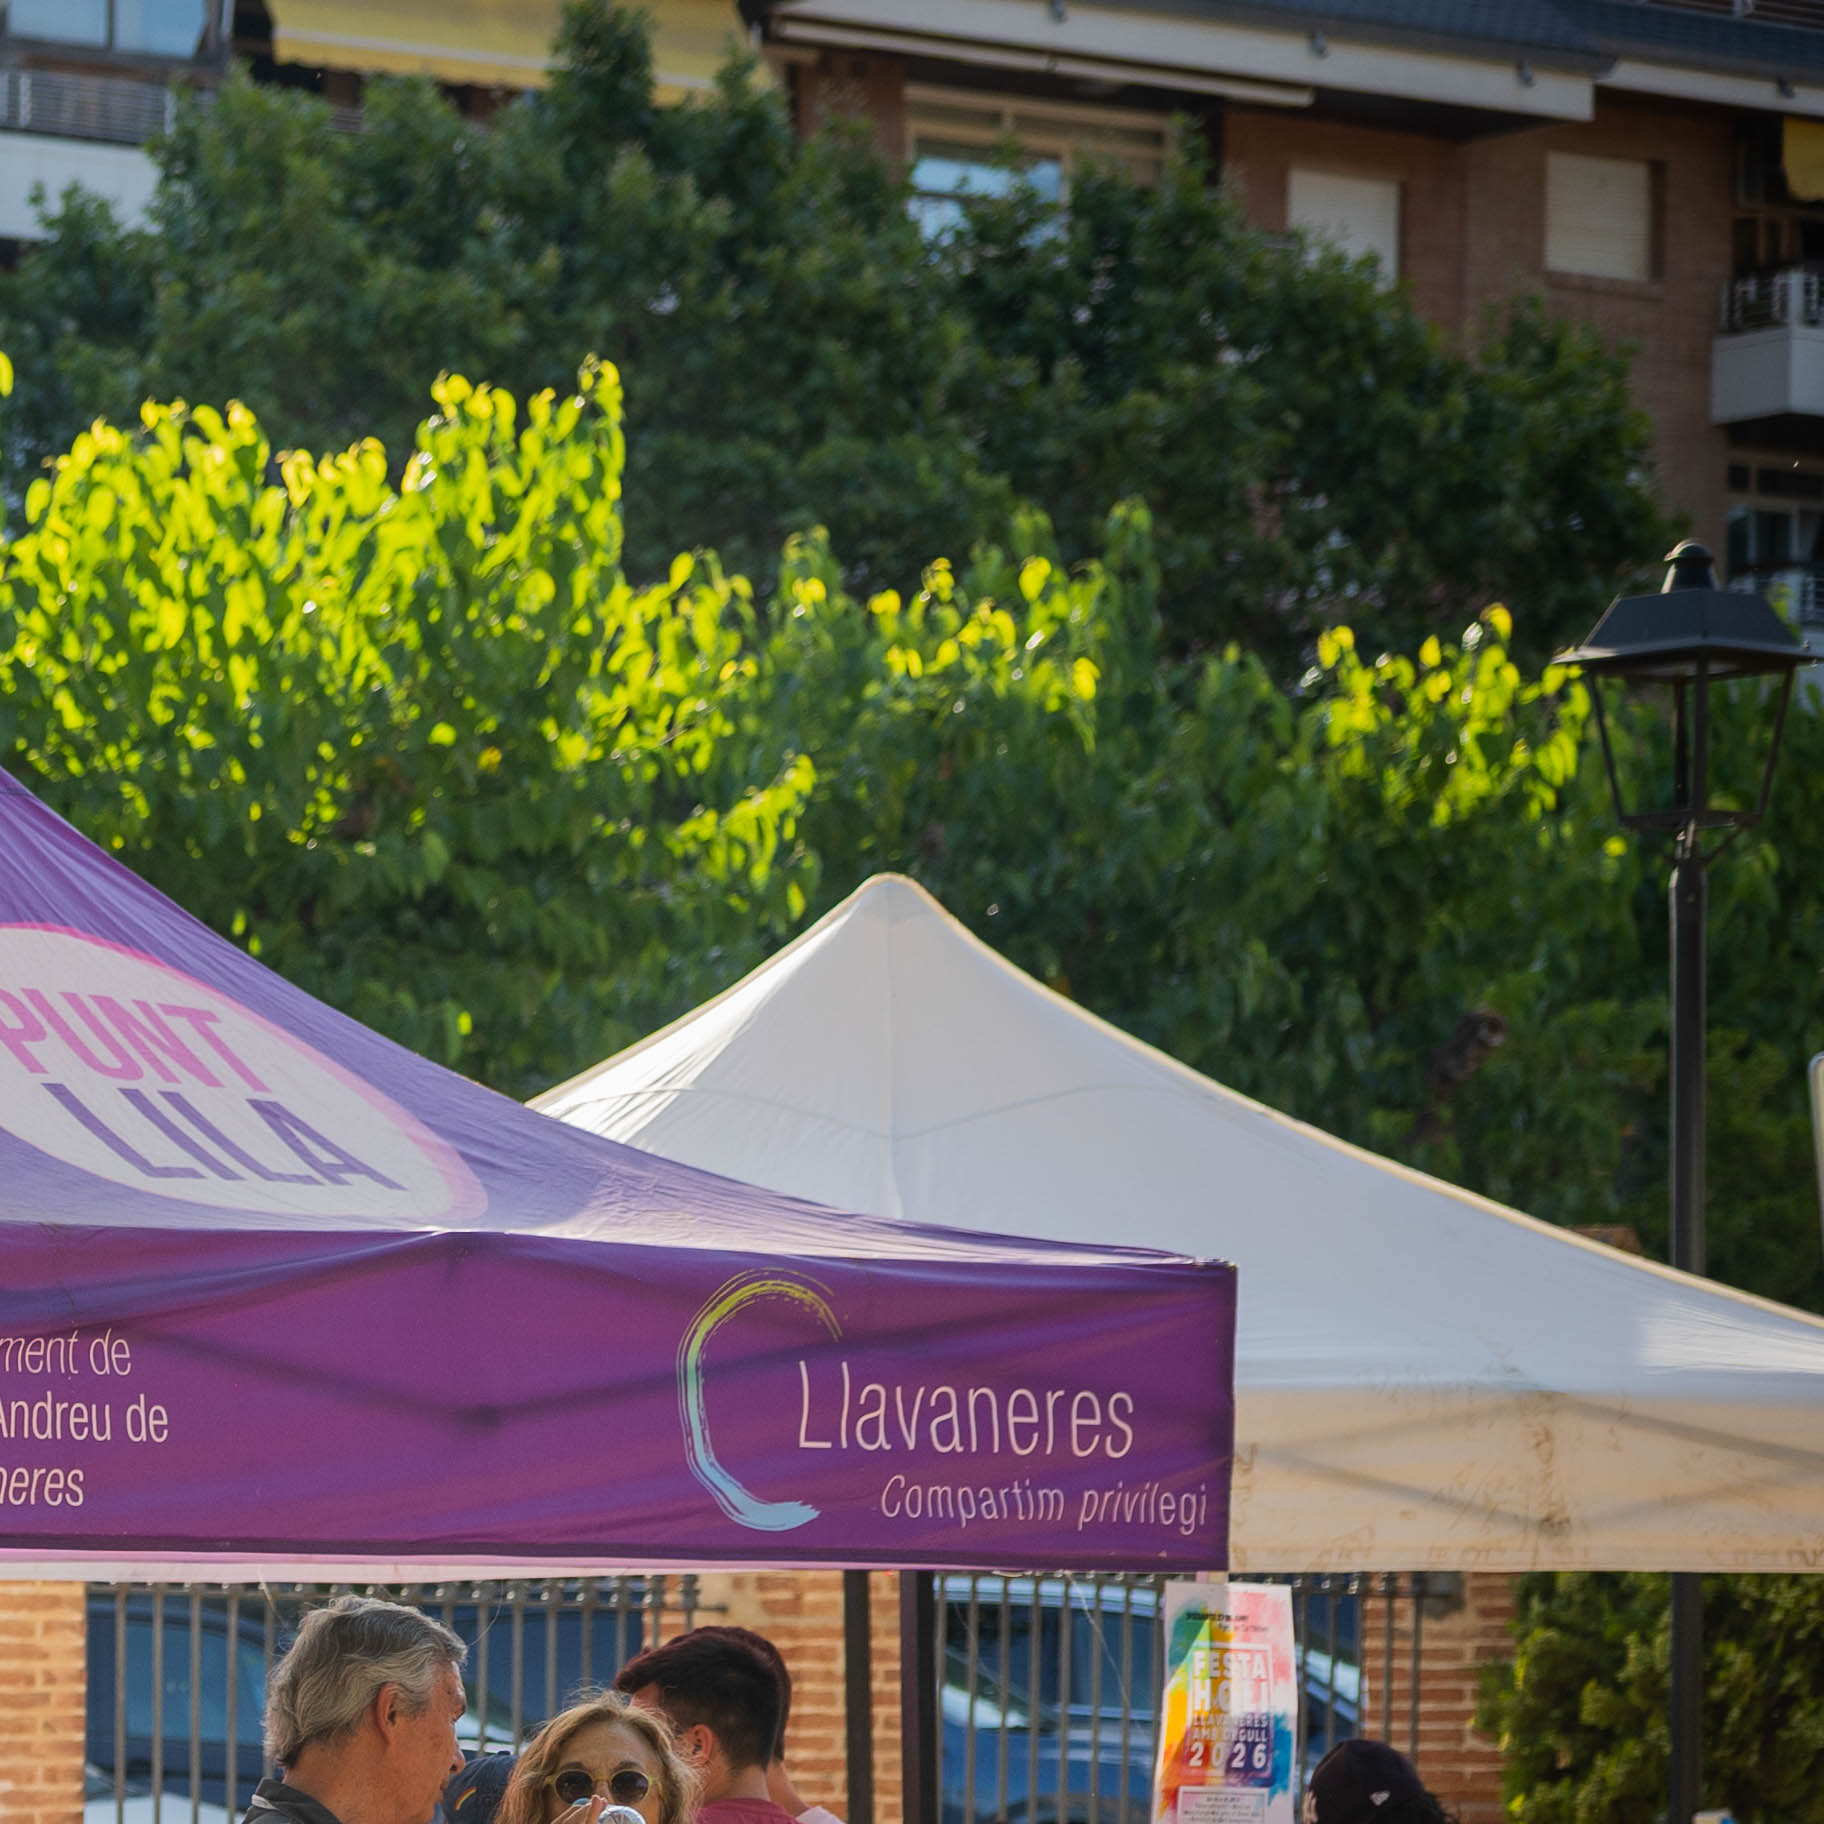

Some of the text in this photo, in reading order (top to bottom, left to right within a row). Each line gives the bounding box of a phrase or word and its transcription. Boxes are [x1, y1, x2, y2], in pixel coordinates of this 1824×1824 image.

[41, 1083, 408, 1191] LILA
[90, 1327, 132, 1376] de
[126, 1396, 169, 1443] de
[798, 1360, 1134, 1459] Llavaneres
[880, 1474, 1207, 1536] Compartim privilegi
[1193, 1651, 1267, 1678] FESTA
[1193, 1679, 1269, 1713] HOLI
[1189, 1741, 1267, 1768] 2026
